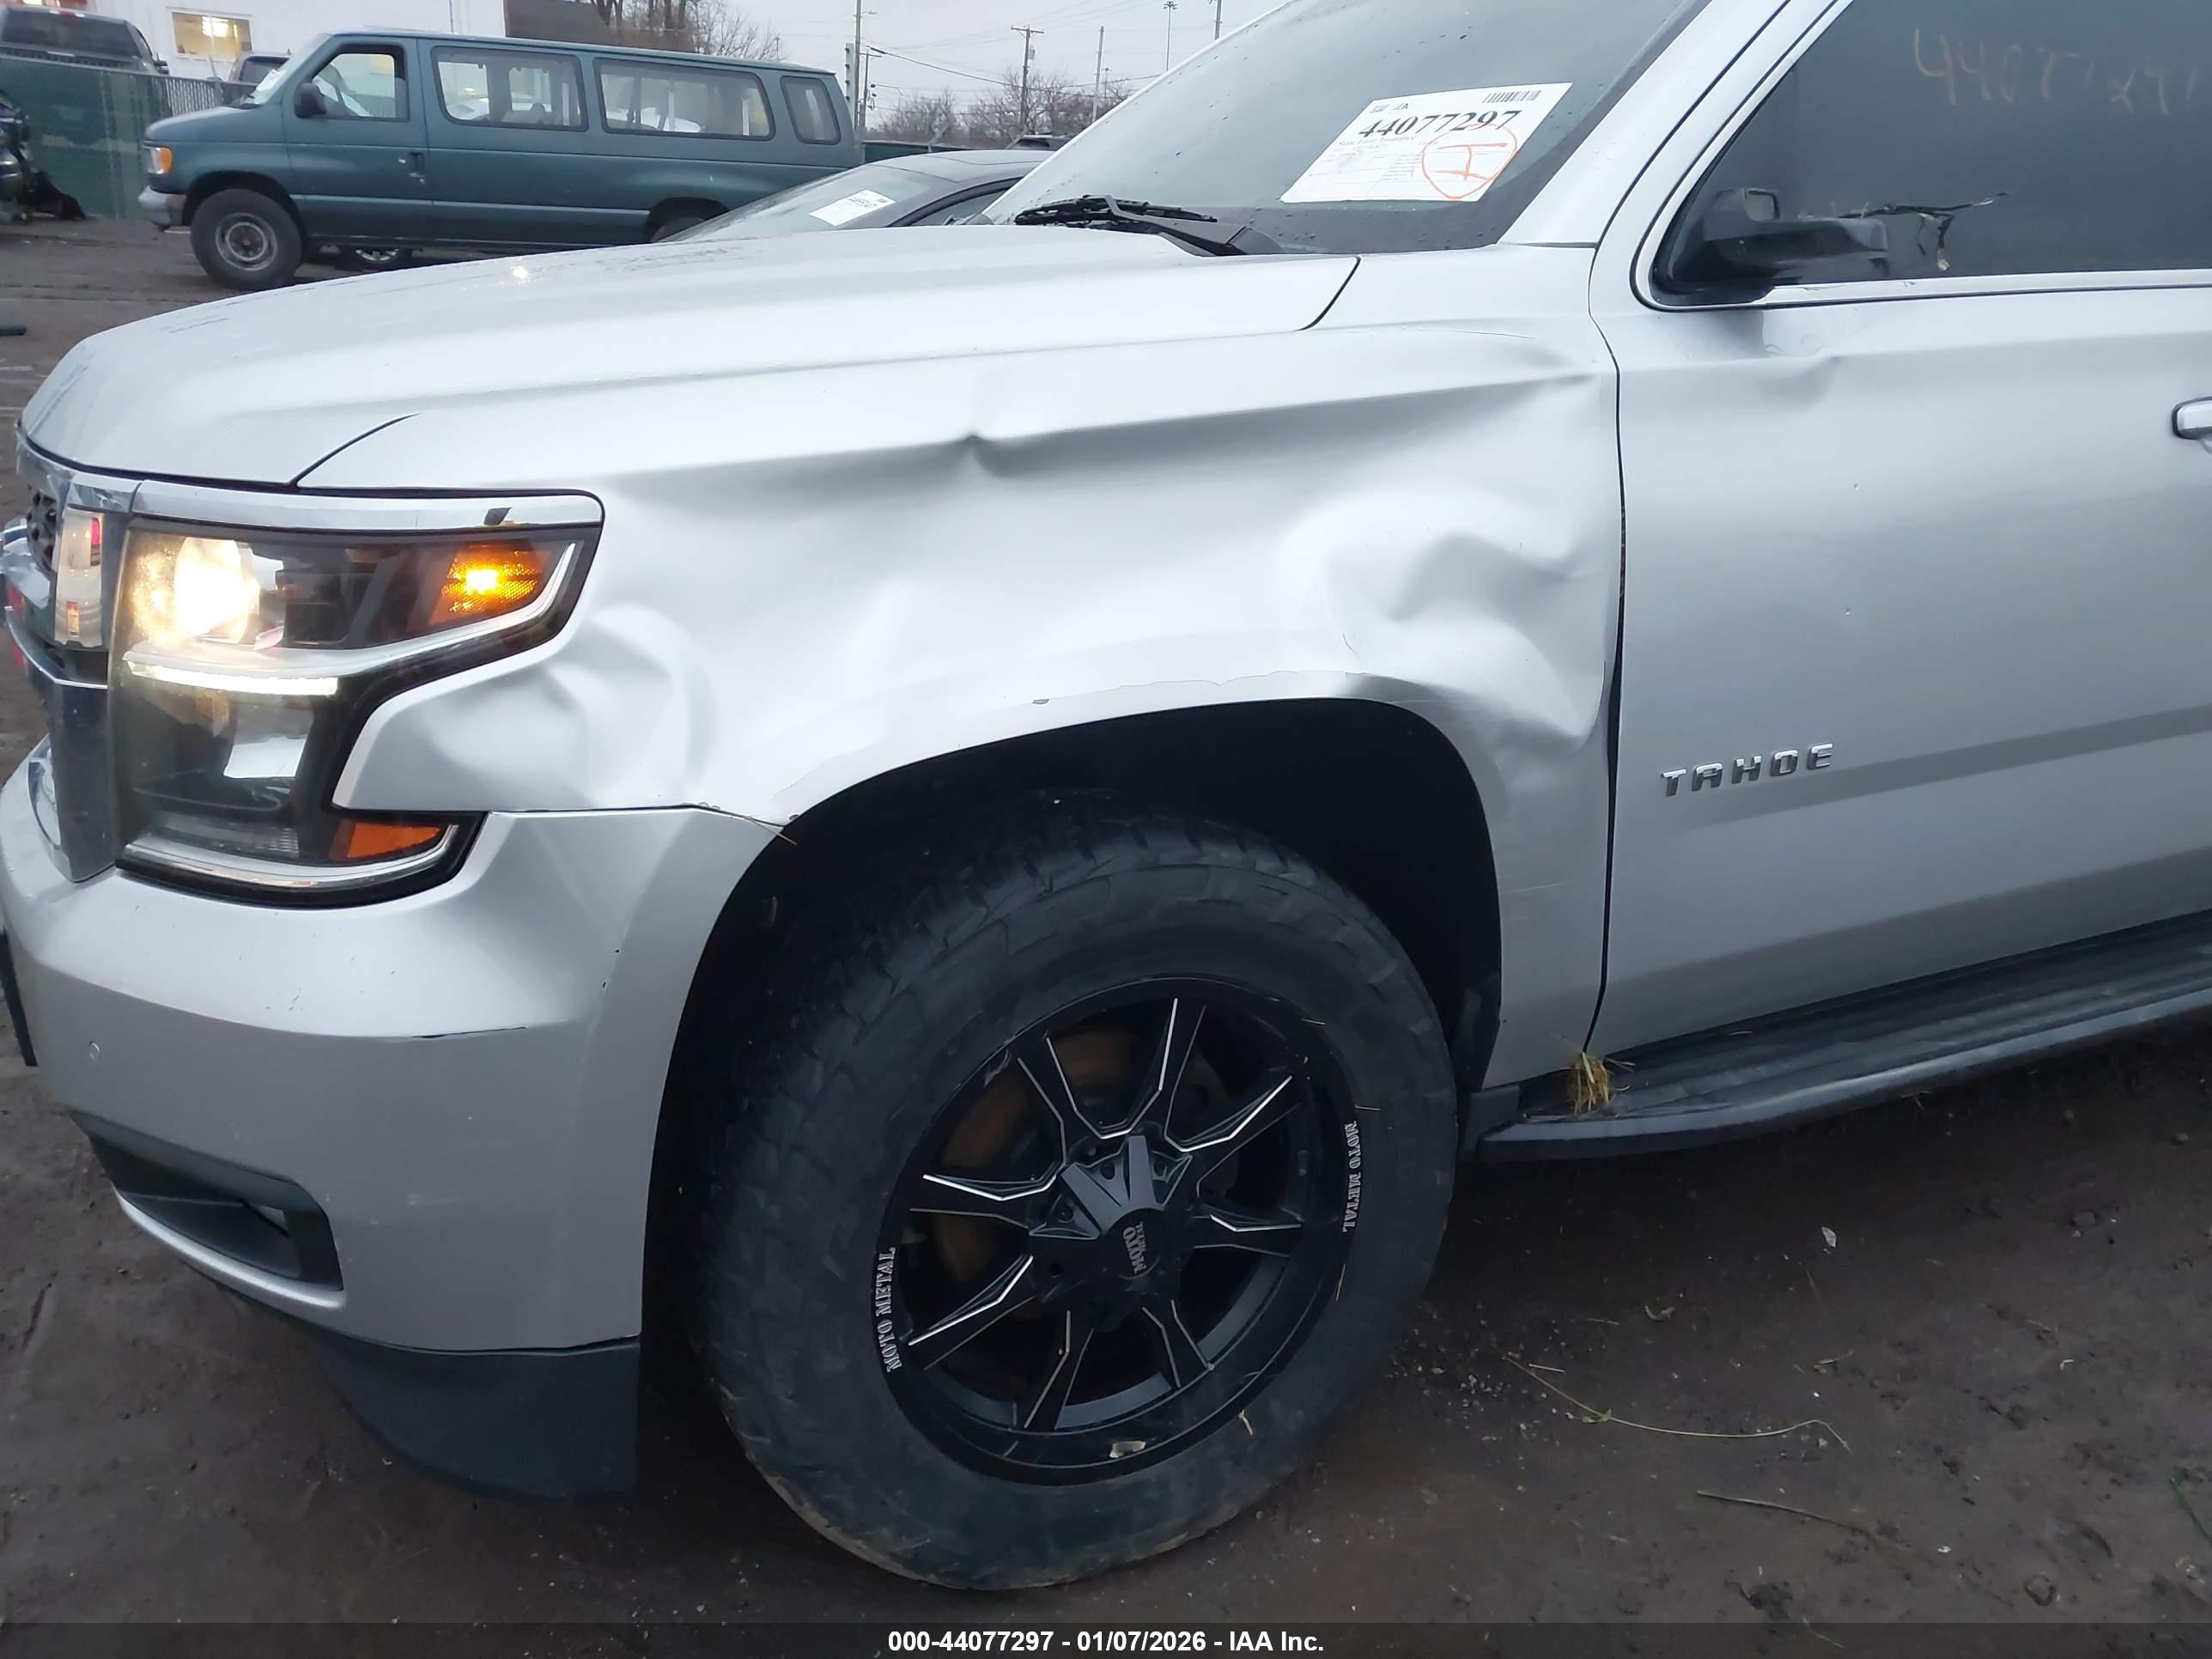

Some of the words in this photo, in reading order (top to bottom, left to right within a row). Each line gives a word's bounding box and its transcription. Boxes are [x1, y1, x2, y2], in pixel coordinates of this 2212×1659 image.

[1358, 110, 1523, 137] 44077297
[1661, 743, 1834, 797] TAHOE
[1344, 1120, 1362, 1170] MOTO
[1341, 1171, 1362, 1233] METAL
[1122, 1226, 1147, 1274] MOTO
[874, 1246, 896, 1317] METAL
[877, 1319, 902, 1373] MOTO
